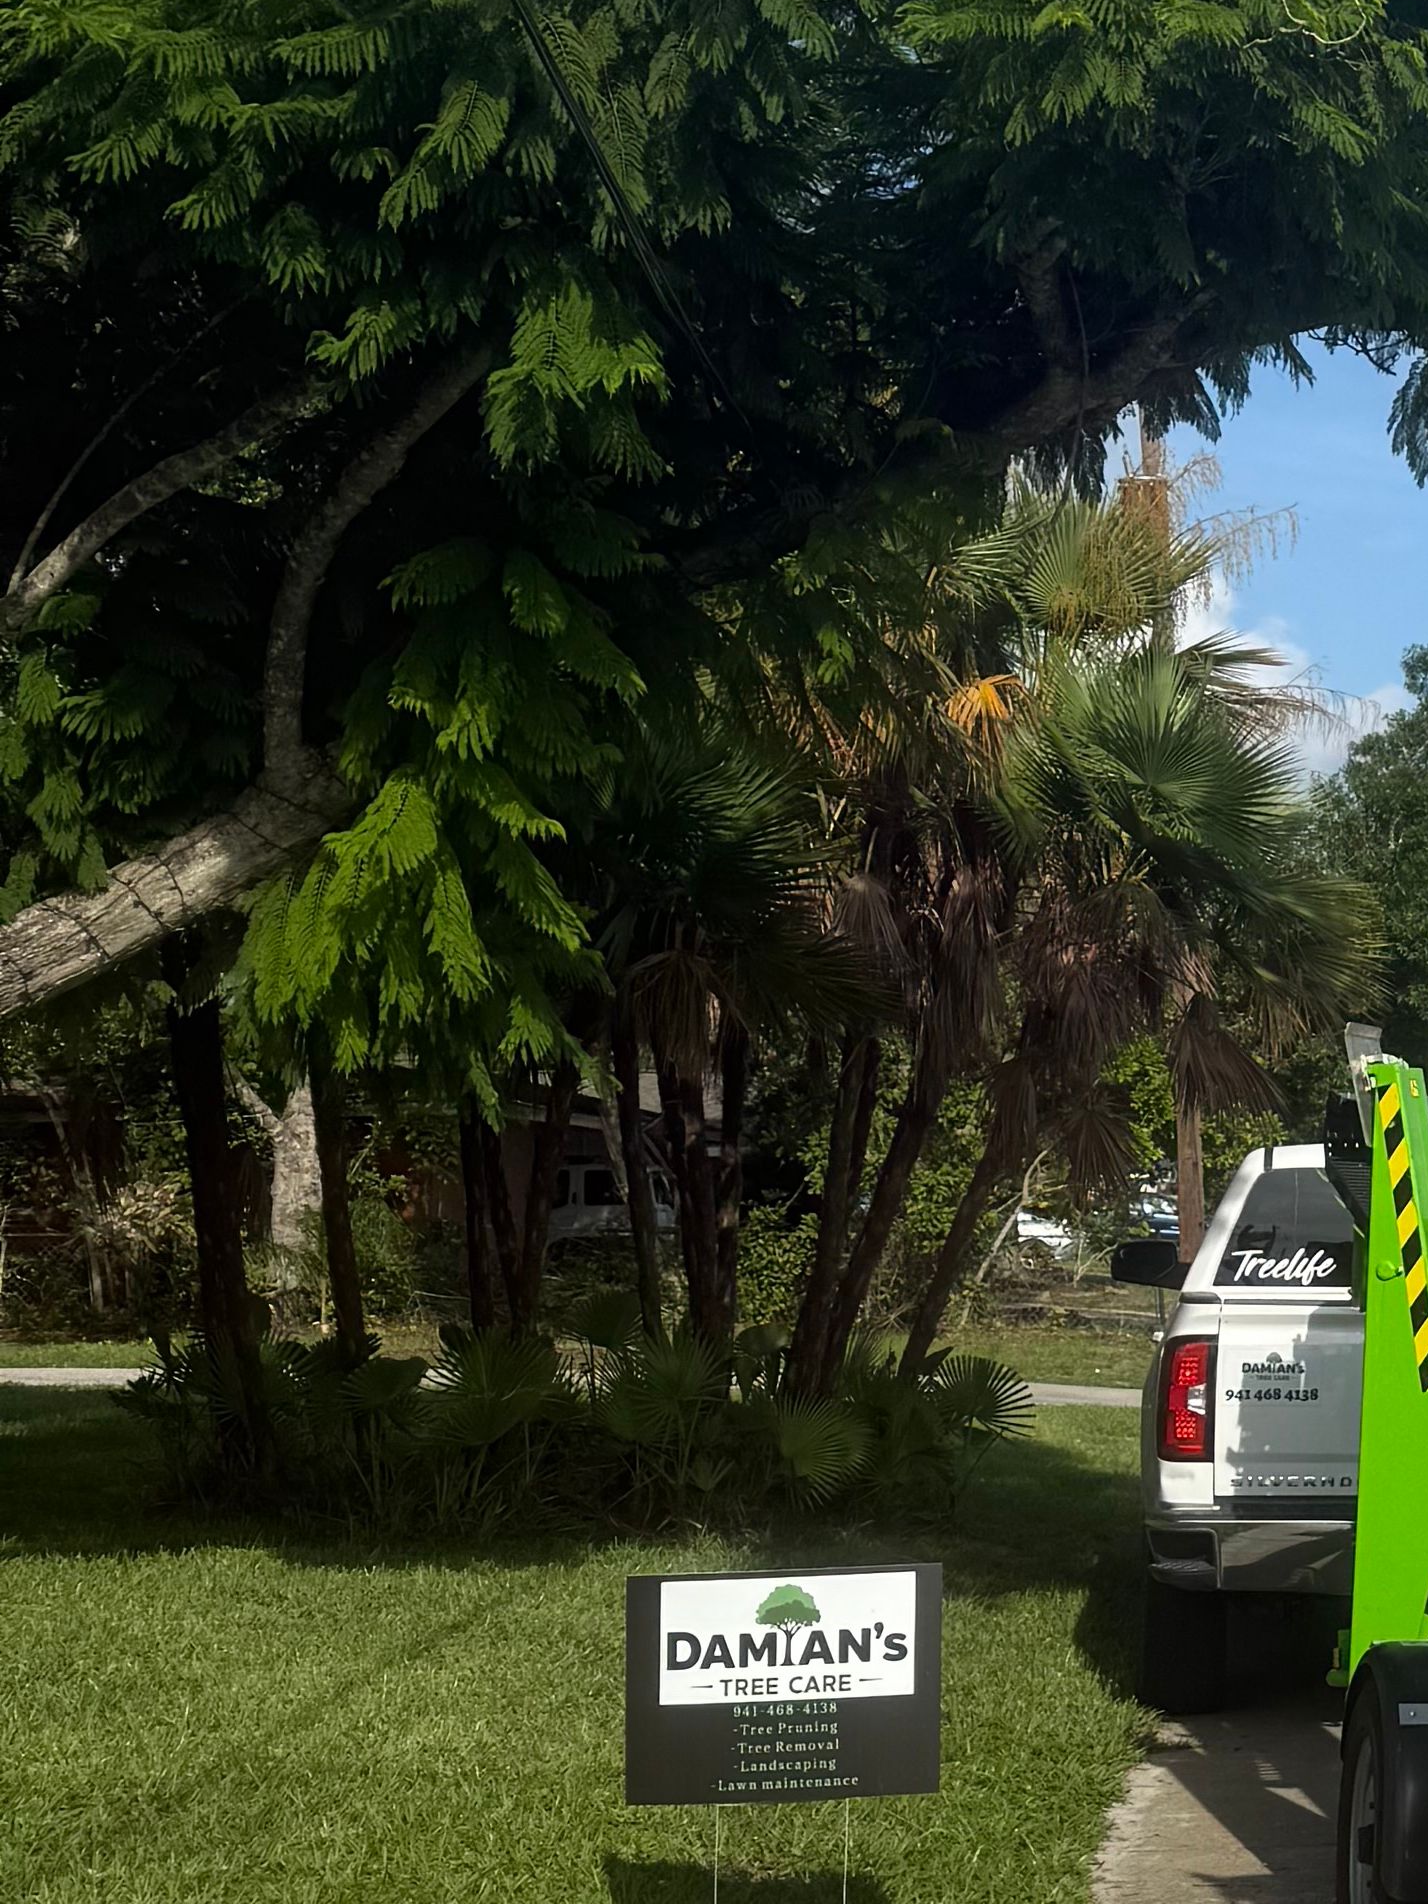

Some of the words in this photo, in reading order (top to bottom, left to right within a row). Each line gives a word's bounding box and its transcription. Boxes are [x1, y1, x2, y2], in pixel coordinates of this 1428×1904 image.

[1231, 1248, 1337, 1286] Treelife
[1225, 1389, 1250, 1402] 941
[1254, 1388, 1281, 1400] 468
[1285, 1388, 1319, 1401] 4138
[720, 1678, 779, 1697] TREE
[789, 1675, 851, 1694] CARE
[733, 1701, 838, 1718] 941-468-4138
[777, 1721, 838, 1735] Pruning
[775, 1738, 840, 1753] Removal
[762, 1776, 860, 1790] maintenance
